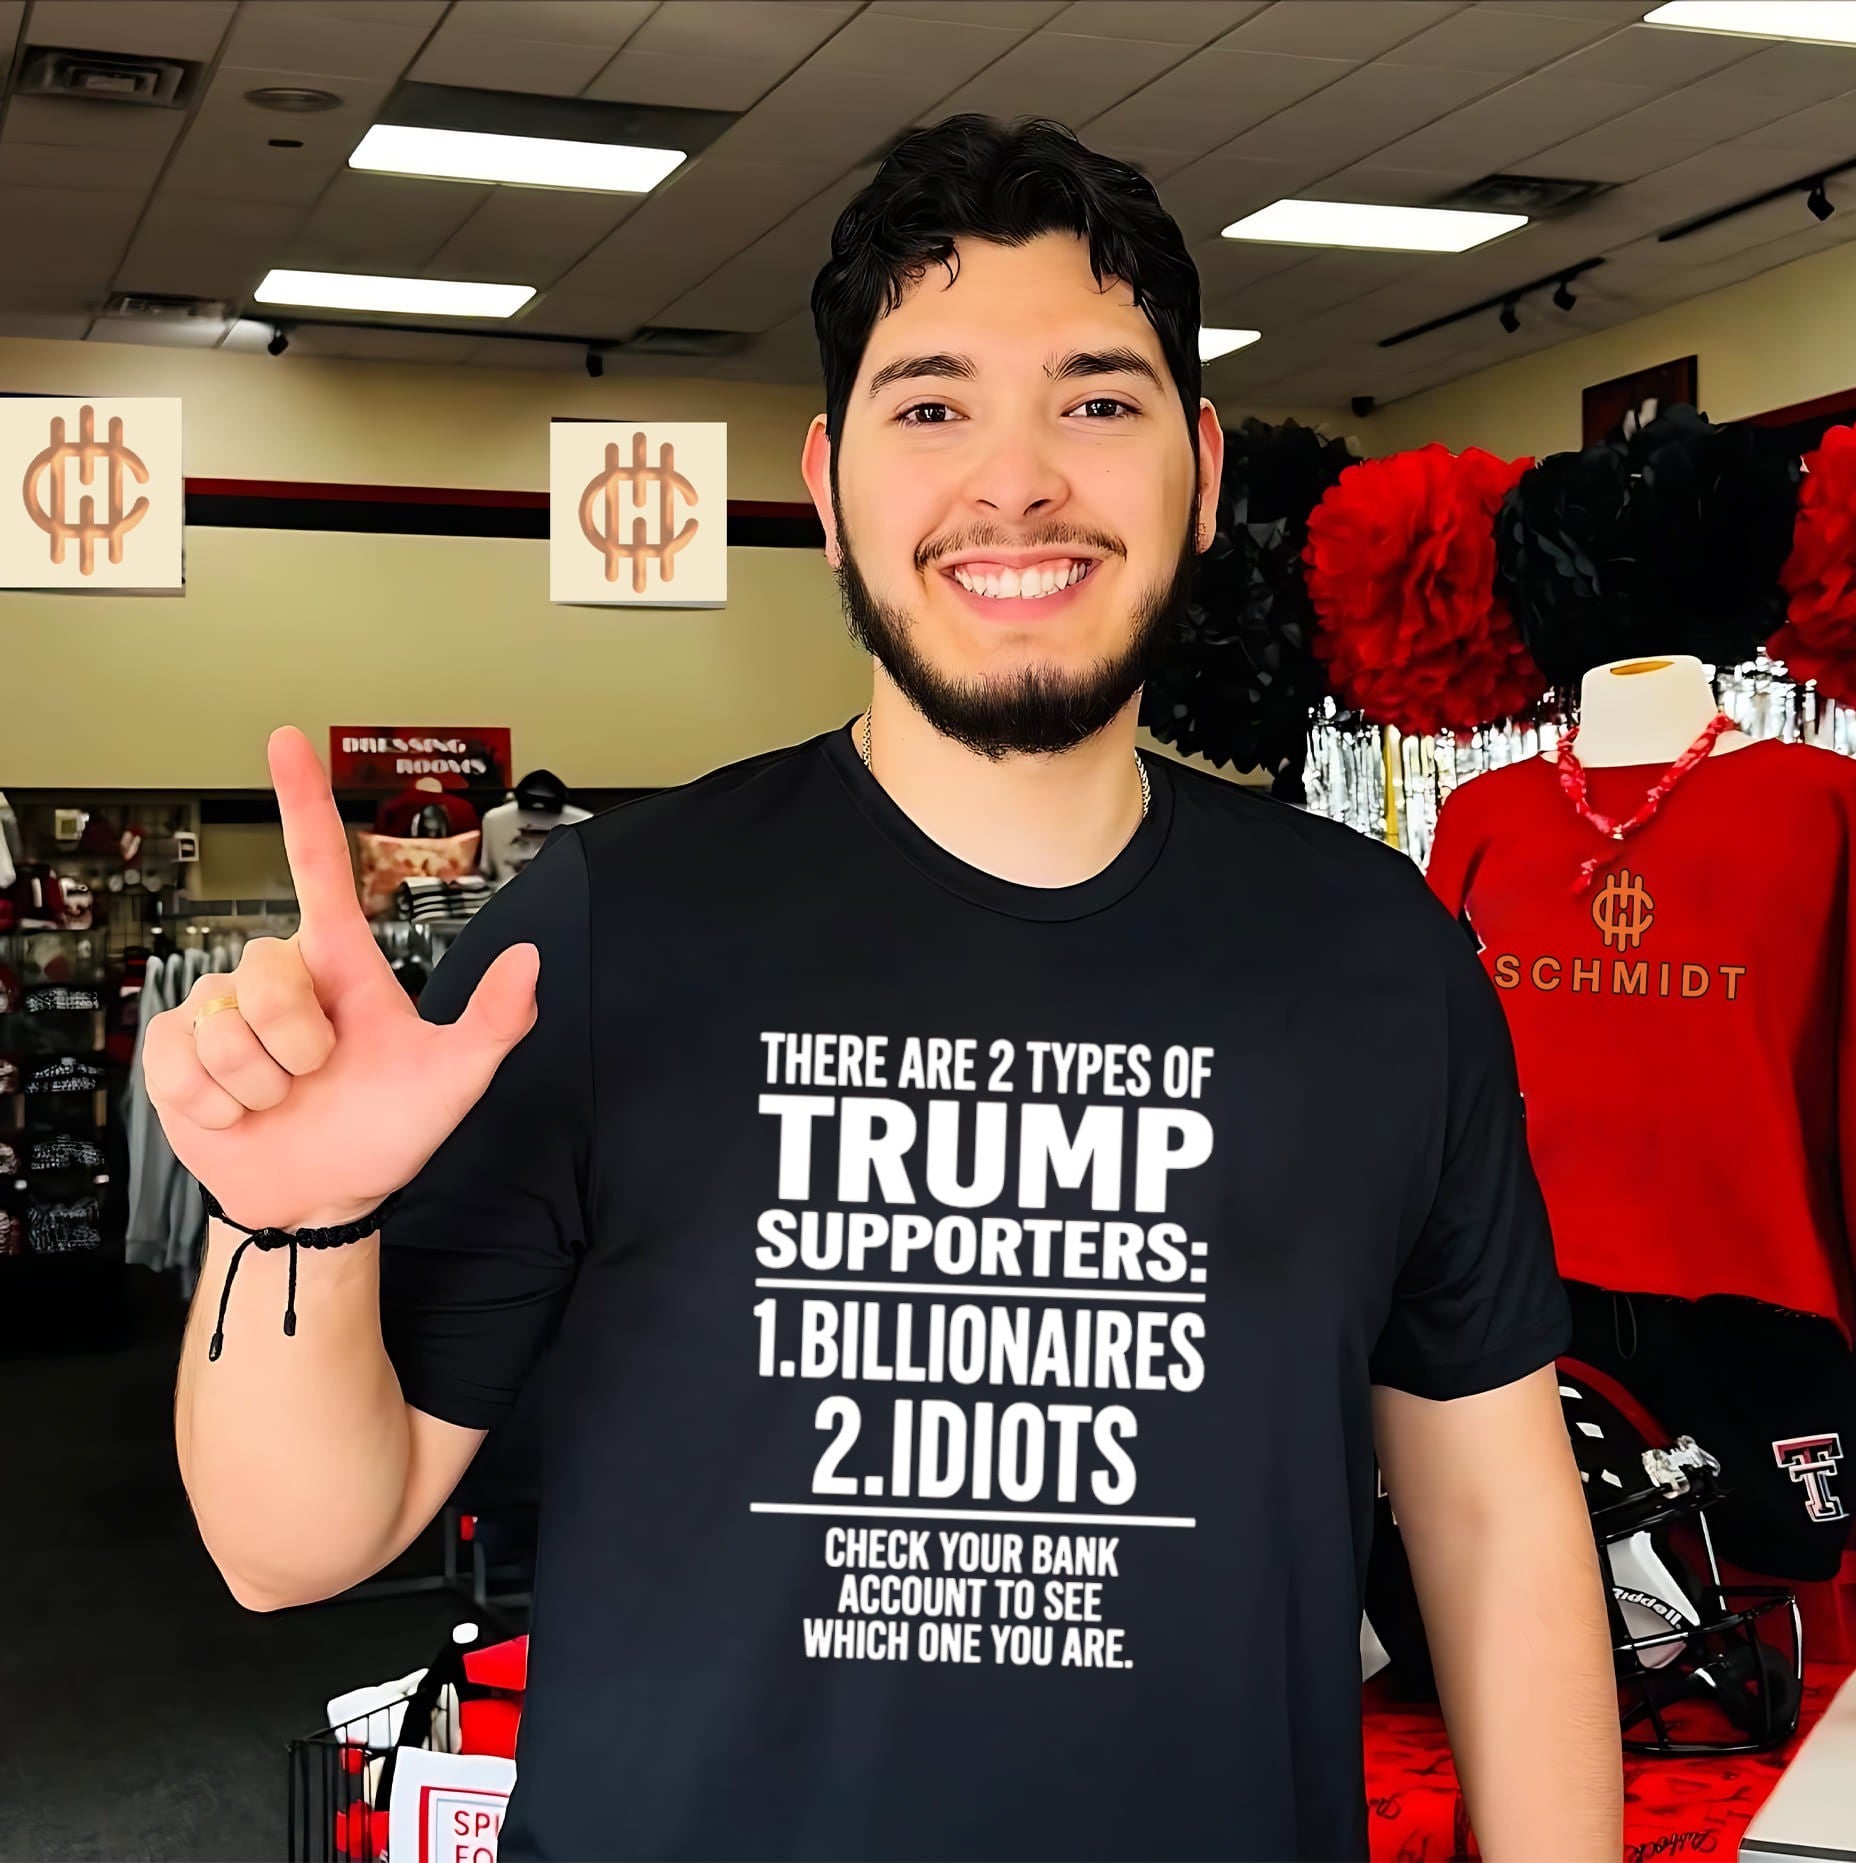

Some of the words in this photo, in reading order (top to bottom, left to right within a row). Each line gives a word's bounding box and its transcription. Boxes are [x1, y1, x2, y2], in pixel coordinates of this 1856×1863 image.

[396, 759, 487, 775] ROOMS
[1493, 953, 1746, 1001] SCHMIDT
[760, 1031, 889, 1088] THERE
[897, 1036, 978, 1091] ARE
[987, 1038, 1015, 1093] 2
[1026, 1041, 1152, 1097] TYPES
[1163, 1045, 1215, 1099] OF
[758, 1093, 1215, 1213] TRUMP
[755, 1208, 1208, 1284] SUPPORTERS:
[825, 1526, 931, 1571] CHECK
[938, 1531, 1024, 1574] YOUR
[1031, 1534, 1120, 1577] BANK
[837, 1573, 988, 1618] ACCOUNT
[994, 1579, 1035, 1620] TO
[1043, 1580, 1103, 1622] SEE
[803, 1617, 909, 1661] WHICH
[918, 1621, 983, 1664] ONE
[990, 1624, 1054, 1666] YOU
[1061, 1627, 1134, 1669] ARE.
